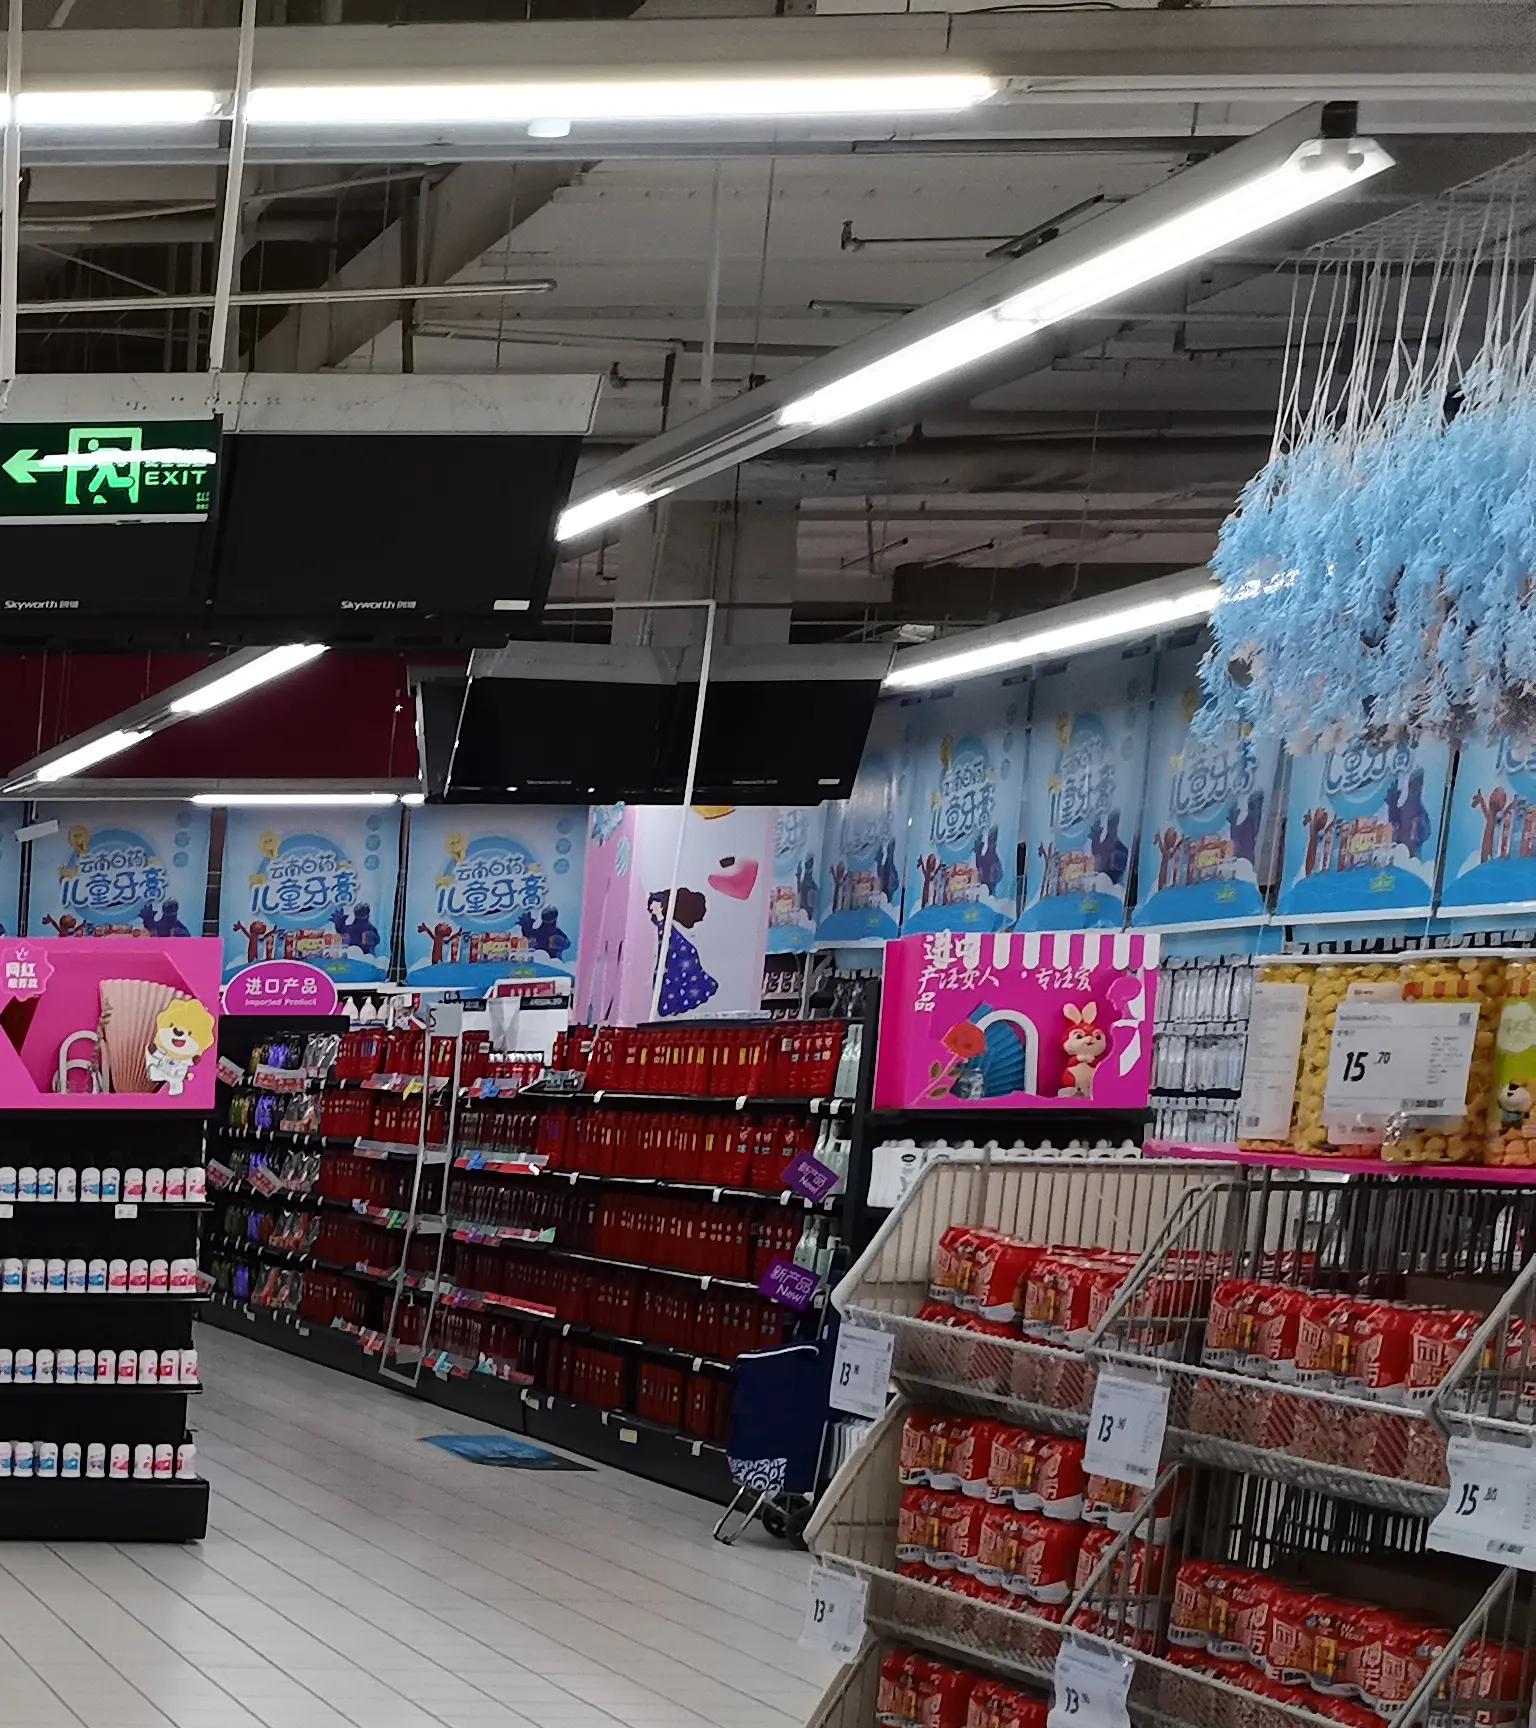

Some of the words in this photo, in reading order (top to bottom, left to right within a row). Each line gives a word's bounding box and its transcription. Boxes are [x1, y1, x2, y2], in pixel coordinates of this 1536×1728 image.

[144, 470, 207, 486] EXIT
[62, 867, 169, 907] 儿童牙膏
[251, 872, 357, 914] 儿童牙膏
[437, 874, 548, 915] 儿童牙膏
[245, 976, 318, 995] 进口产品
